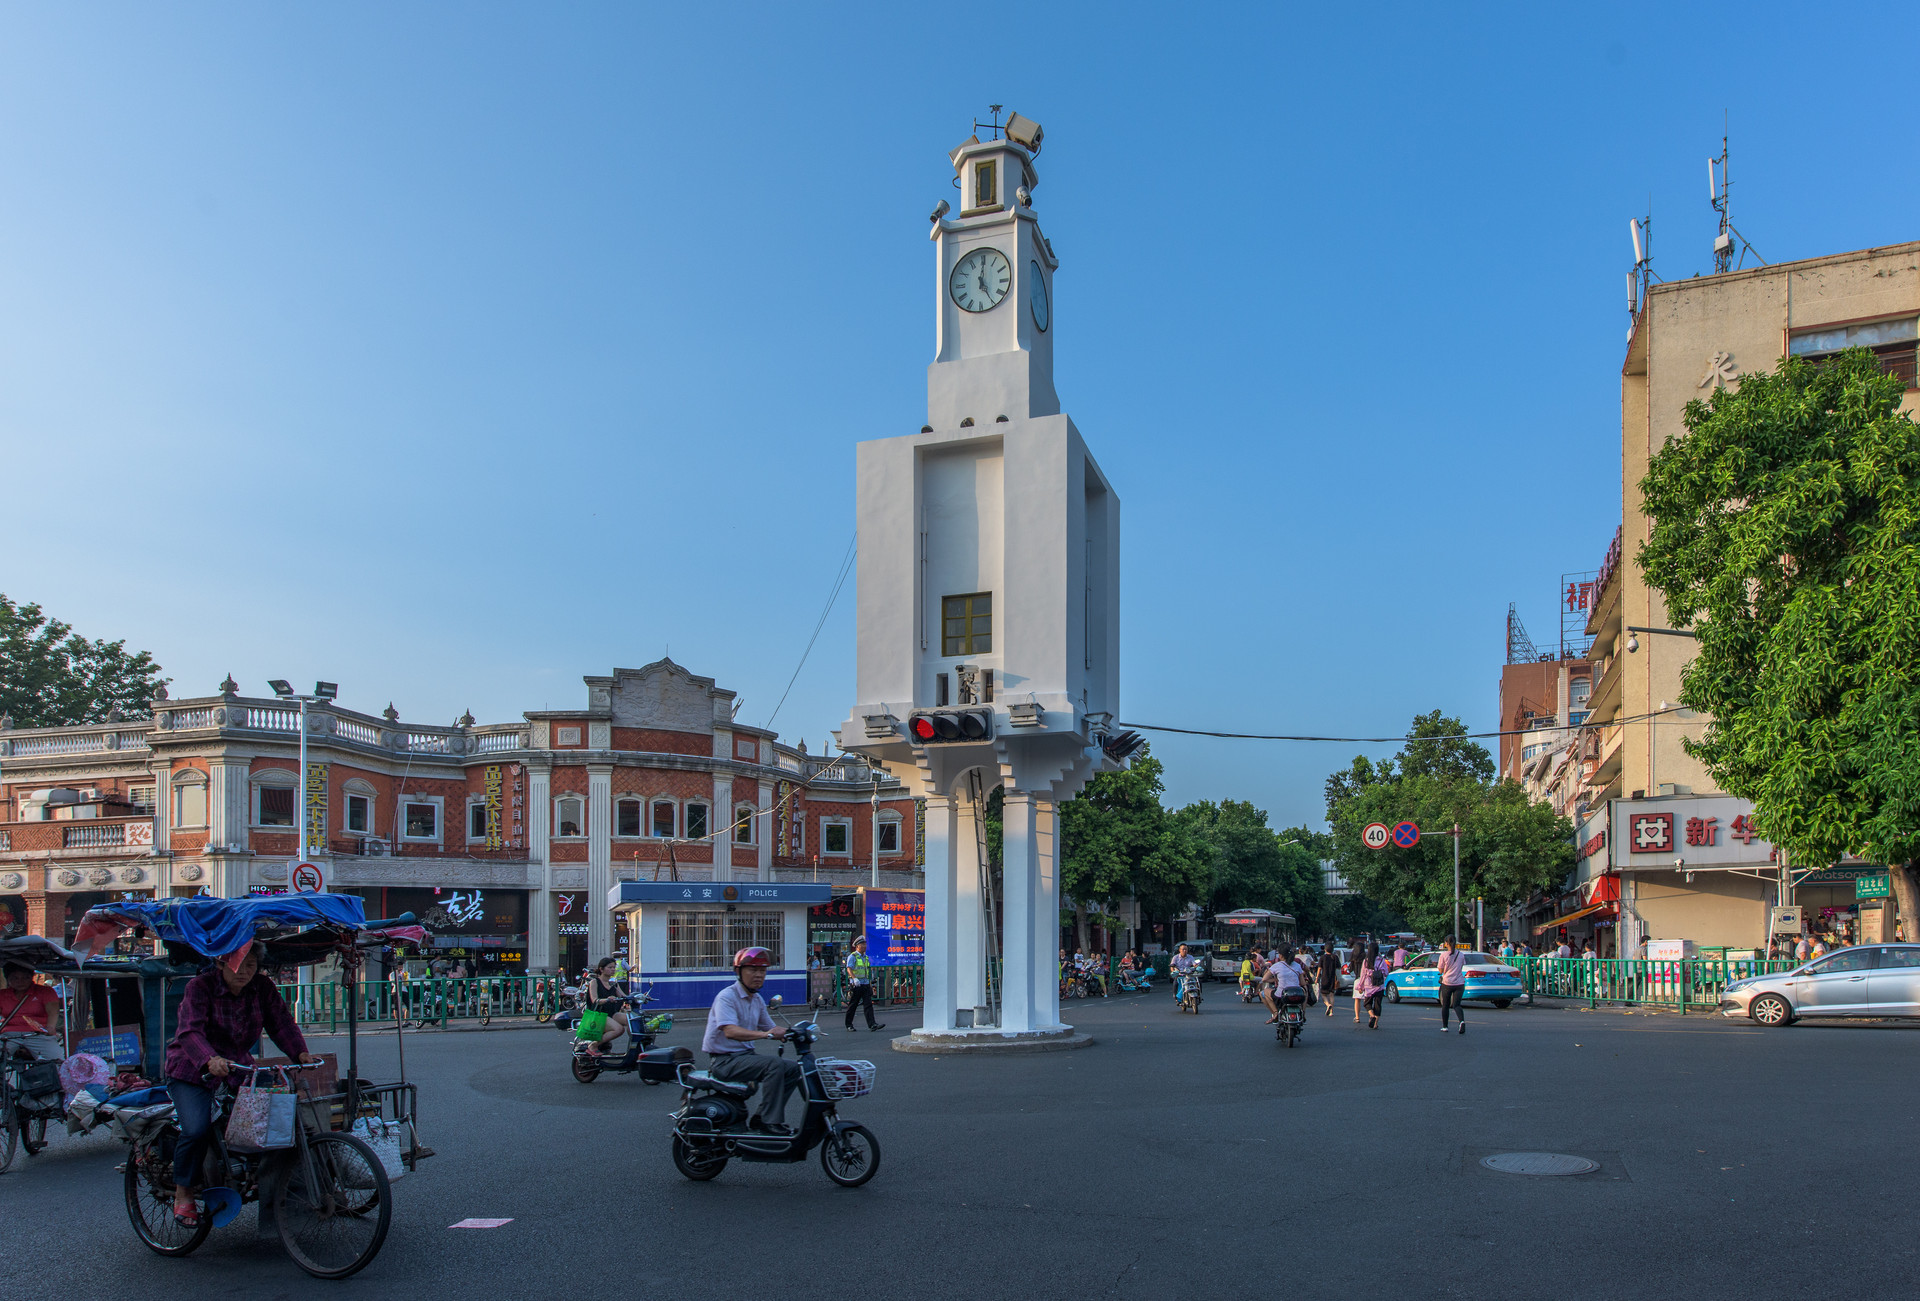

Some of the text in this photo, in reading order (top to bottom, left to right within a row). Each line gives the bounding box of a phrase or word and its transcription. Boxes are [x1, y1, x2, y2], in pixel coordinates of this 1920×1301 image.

[1368, 830, 1384, 841] 40
[1812, 870, 1868, 880] watsons
[682, 888, 778, 898] 公安 POLICE
[875, 914, 925, 930] 到泉兴
